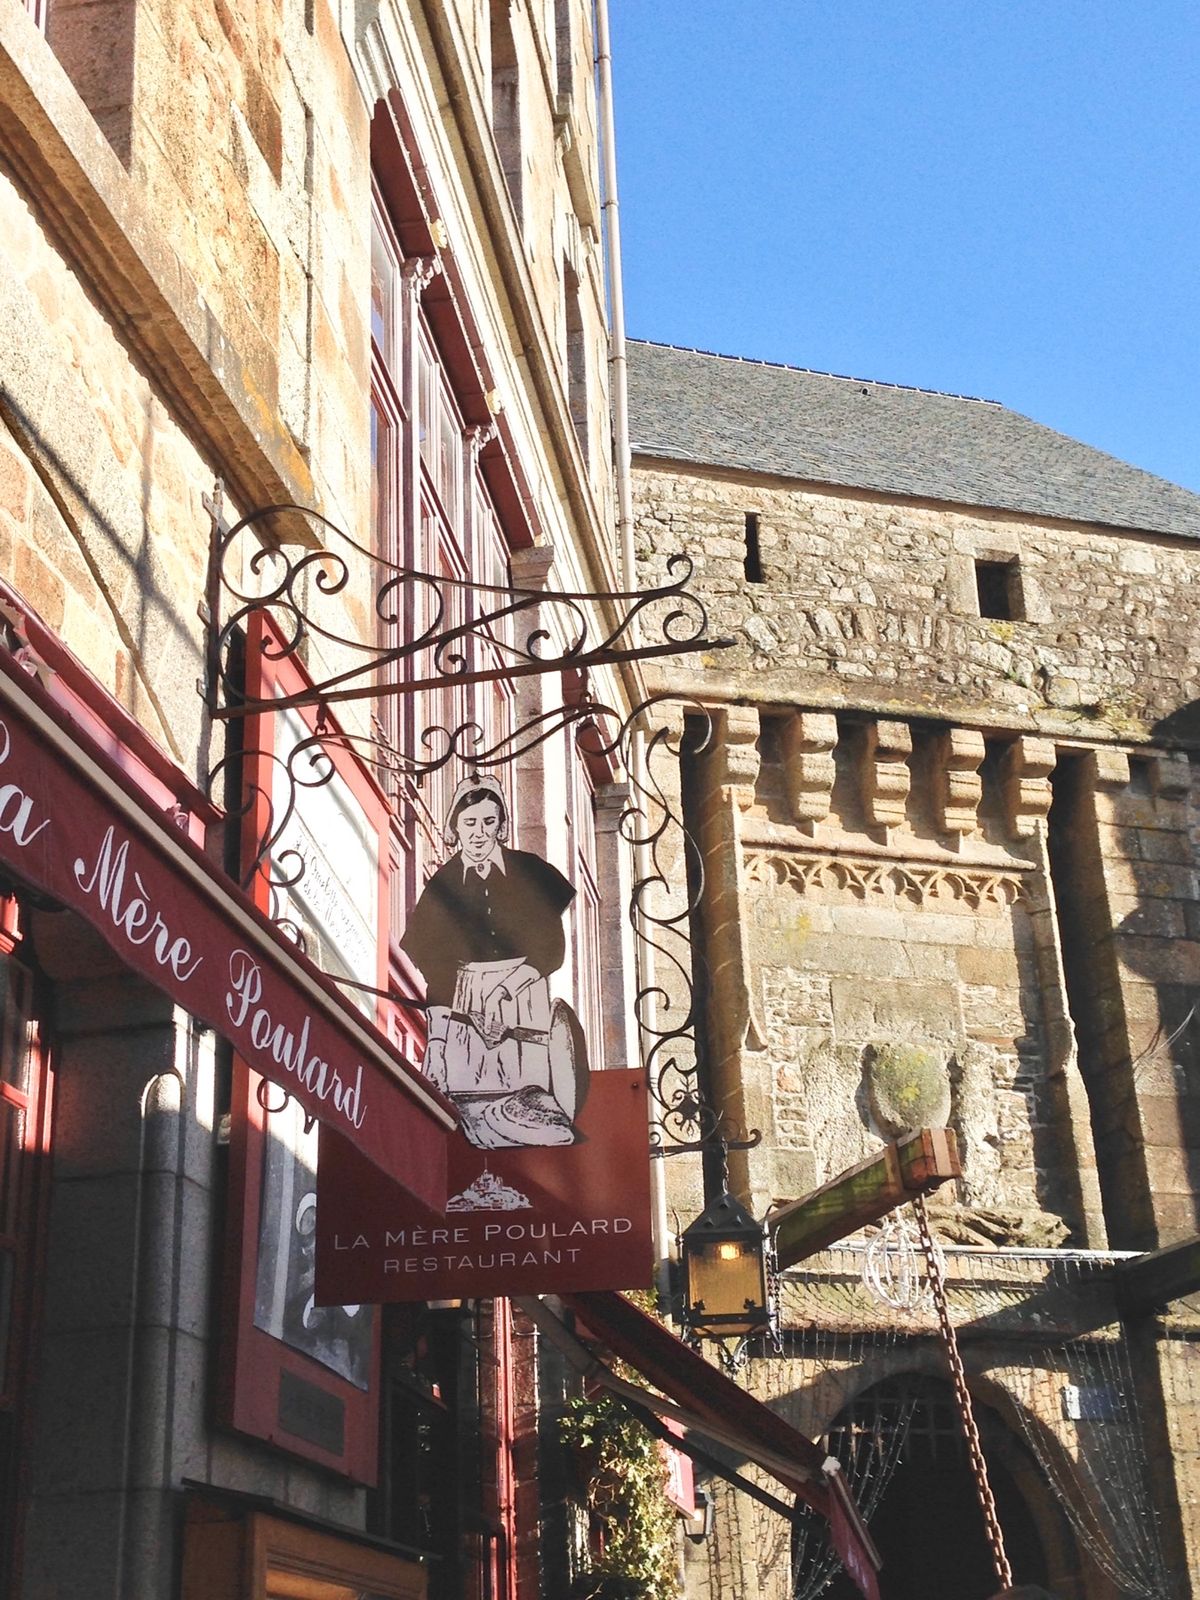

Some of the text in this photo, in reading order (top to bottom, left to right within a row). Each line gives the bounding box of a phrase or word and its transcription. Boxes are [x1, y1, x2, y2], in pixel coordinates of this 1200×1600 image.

[74, 825, 203, 982] Mère
[226, 949, 368, 1129] Poulard
[334, 1218, 633, 1250] LA MÈRE POULARD
[383, 1248, 581, 1274] RESTAURANT
